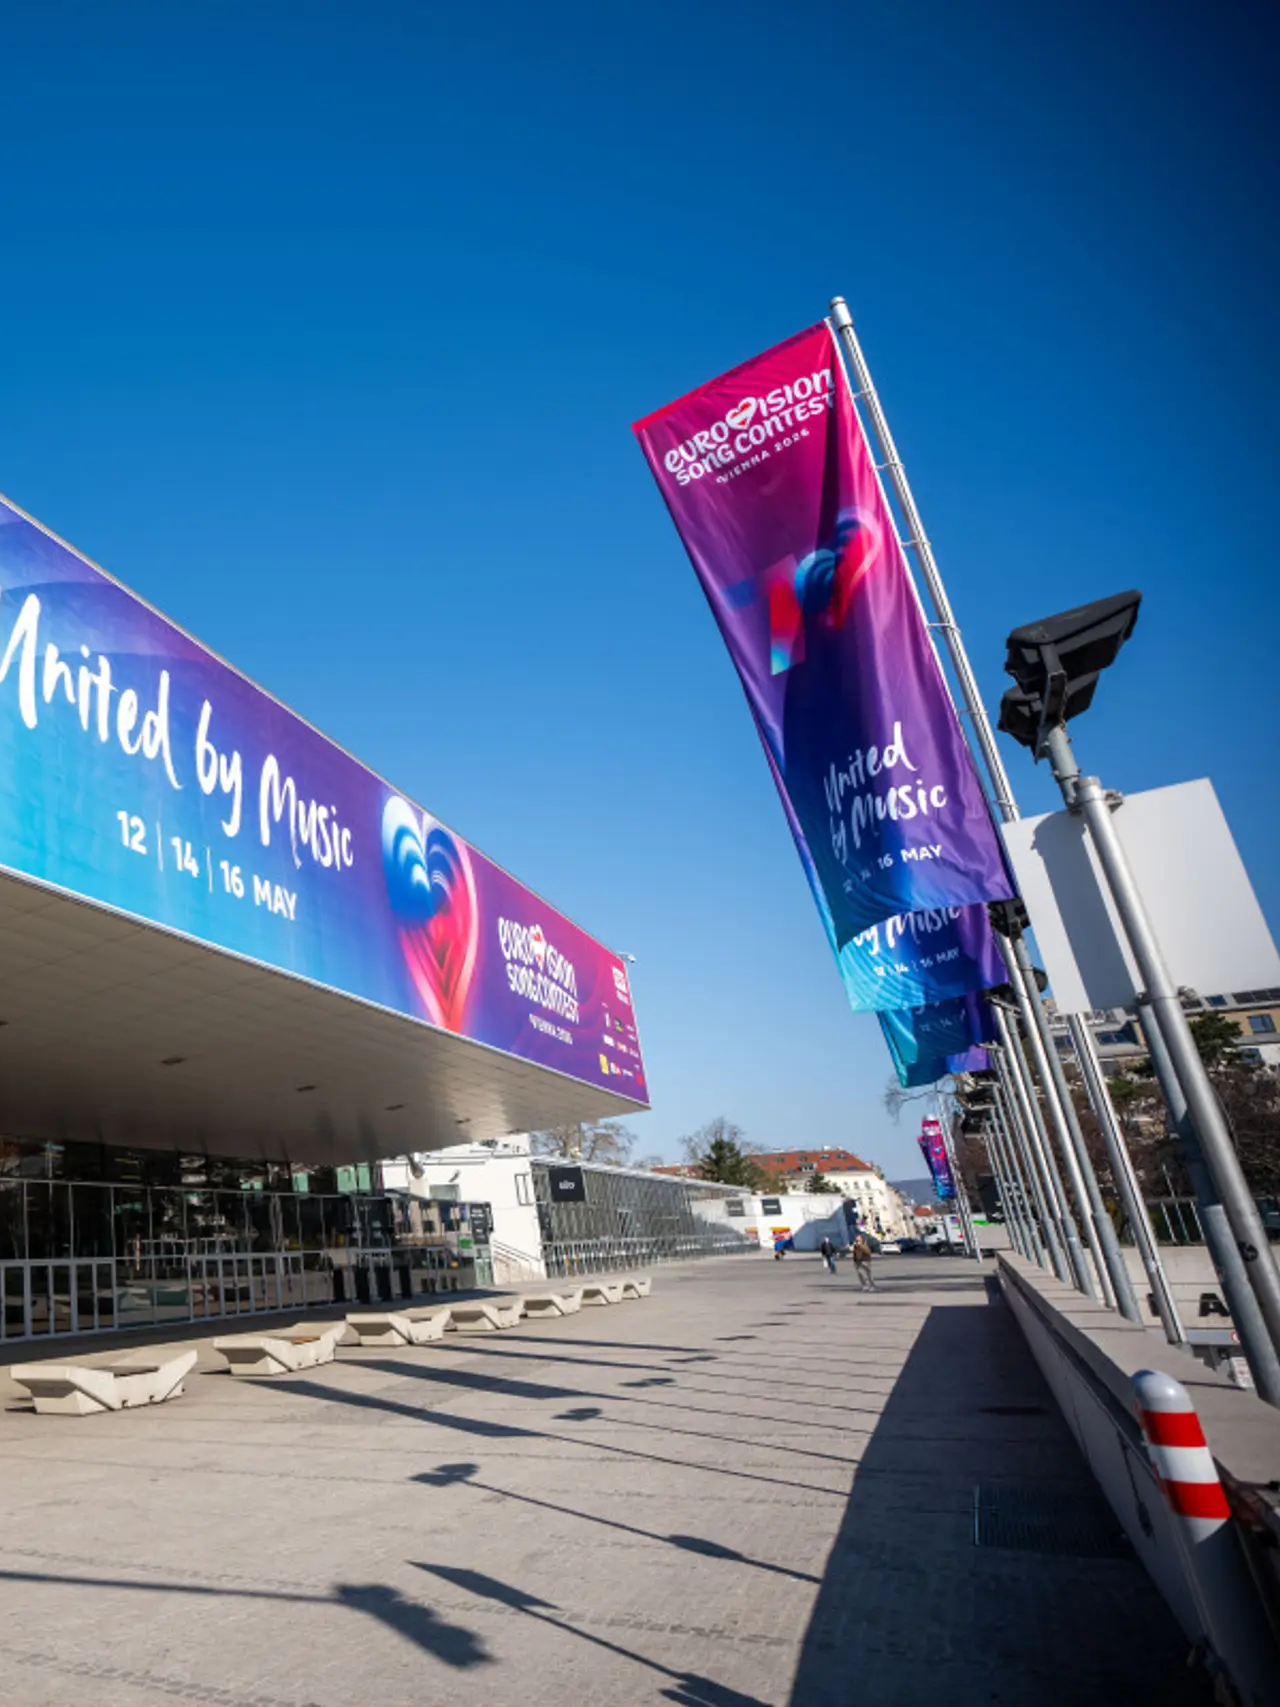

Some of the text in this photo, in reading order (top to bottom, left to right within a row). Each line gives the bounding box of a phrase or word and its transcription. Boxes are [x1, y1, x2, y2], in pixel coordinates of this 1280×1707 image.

[716, 427, 810, 484] VIENNA 2026
[196, 699, 242, 838] by
[259, 754, 354, 872] Music
[824, 721, 918, 814] United
[851, 779, 947, 849] Music
[117, 810, 297, 921] 12 14 16 MAY
[877, 853, 894, 869] 16
[900, 844, 942, 863] MAY
